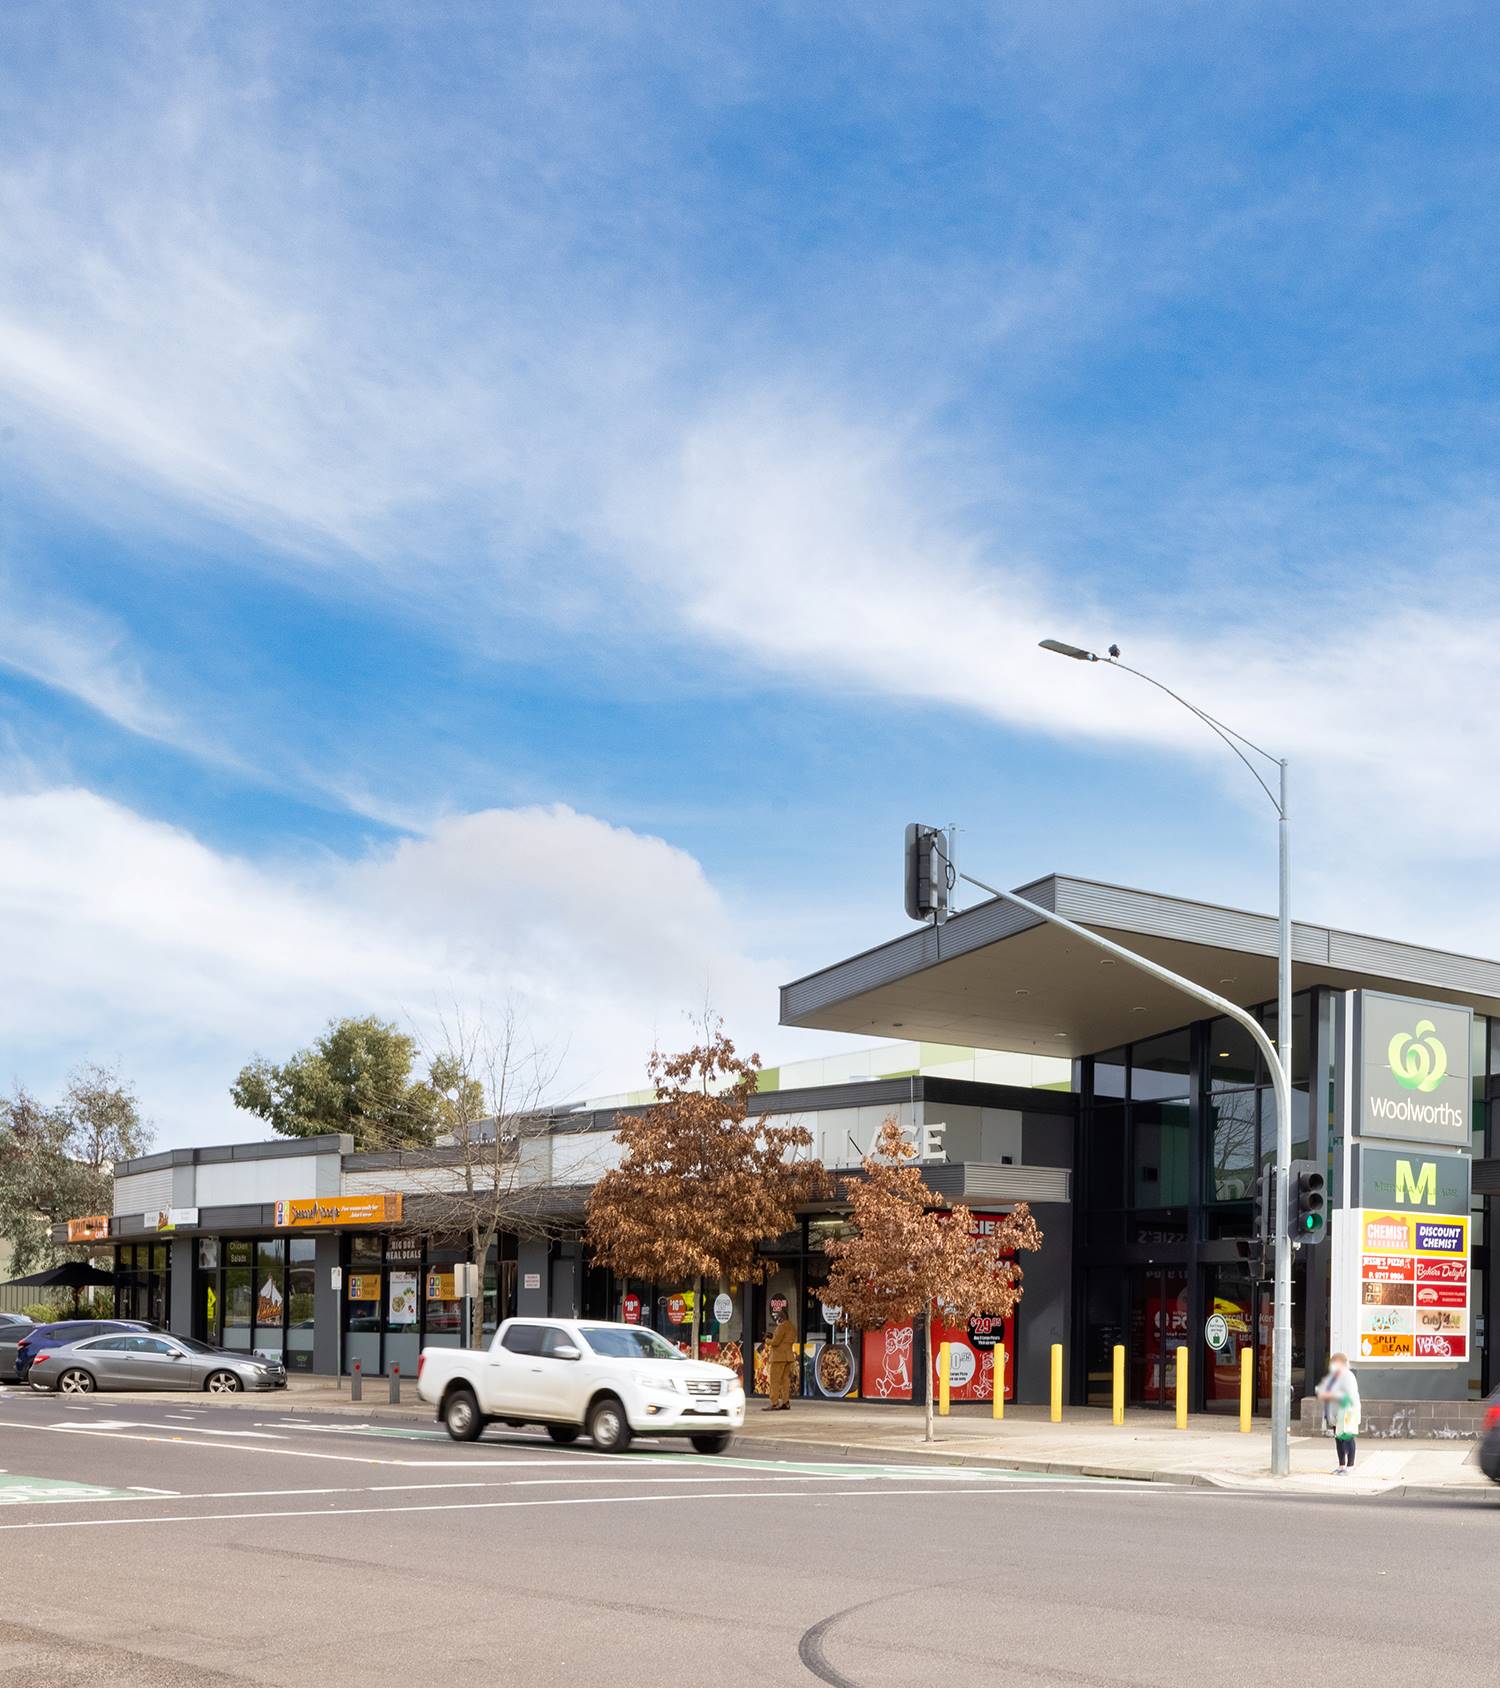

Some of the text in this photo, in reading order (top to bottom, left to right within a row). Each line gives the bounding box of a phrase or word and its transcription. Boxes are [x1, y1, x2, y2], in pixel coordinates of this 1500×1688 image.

[1370, 1096, 1463, 1127] Woolworths
[1395, 1159, 1437, 1206] M
[1367, 1223, 1408, 1241] CHEMIST
[1420, 1225, 1461, 1238] DISCOUNT
[1423, 1238, 1457, 1249] CHEMIST
[1441, 1265, 1466, 1281] Delight
